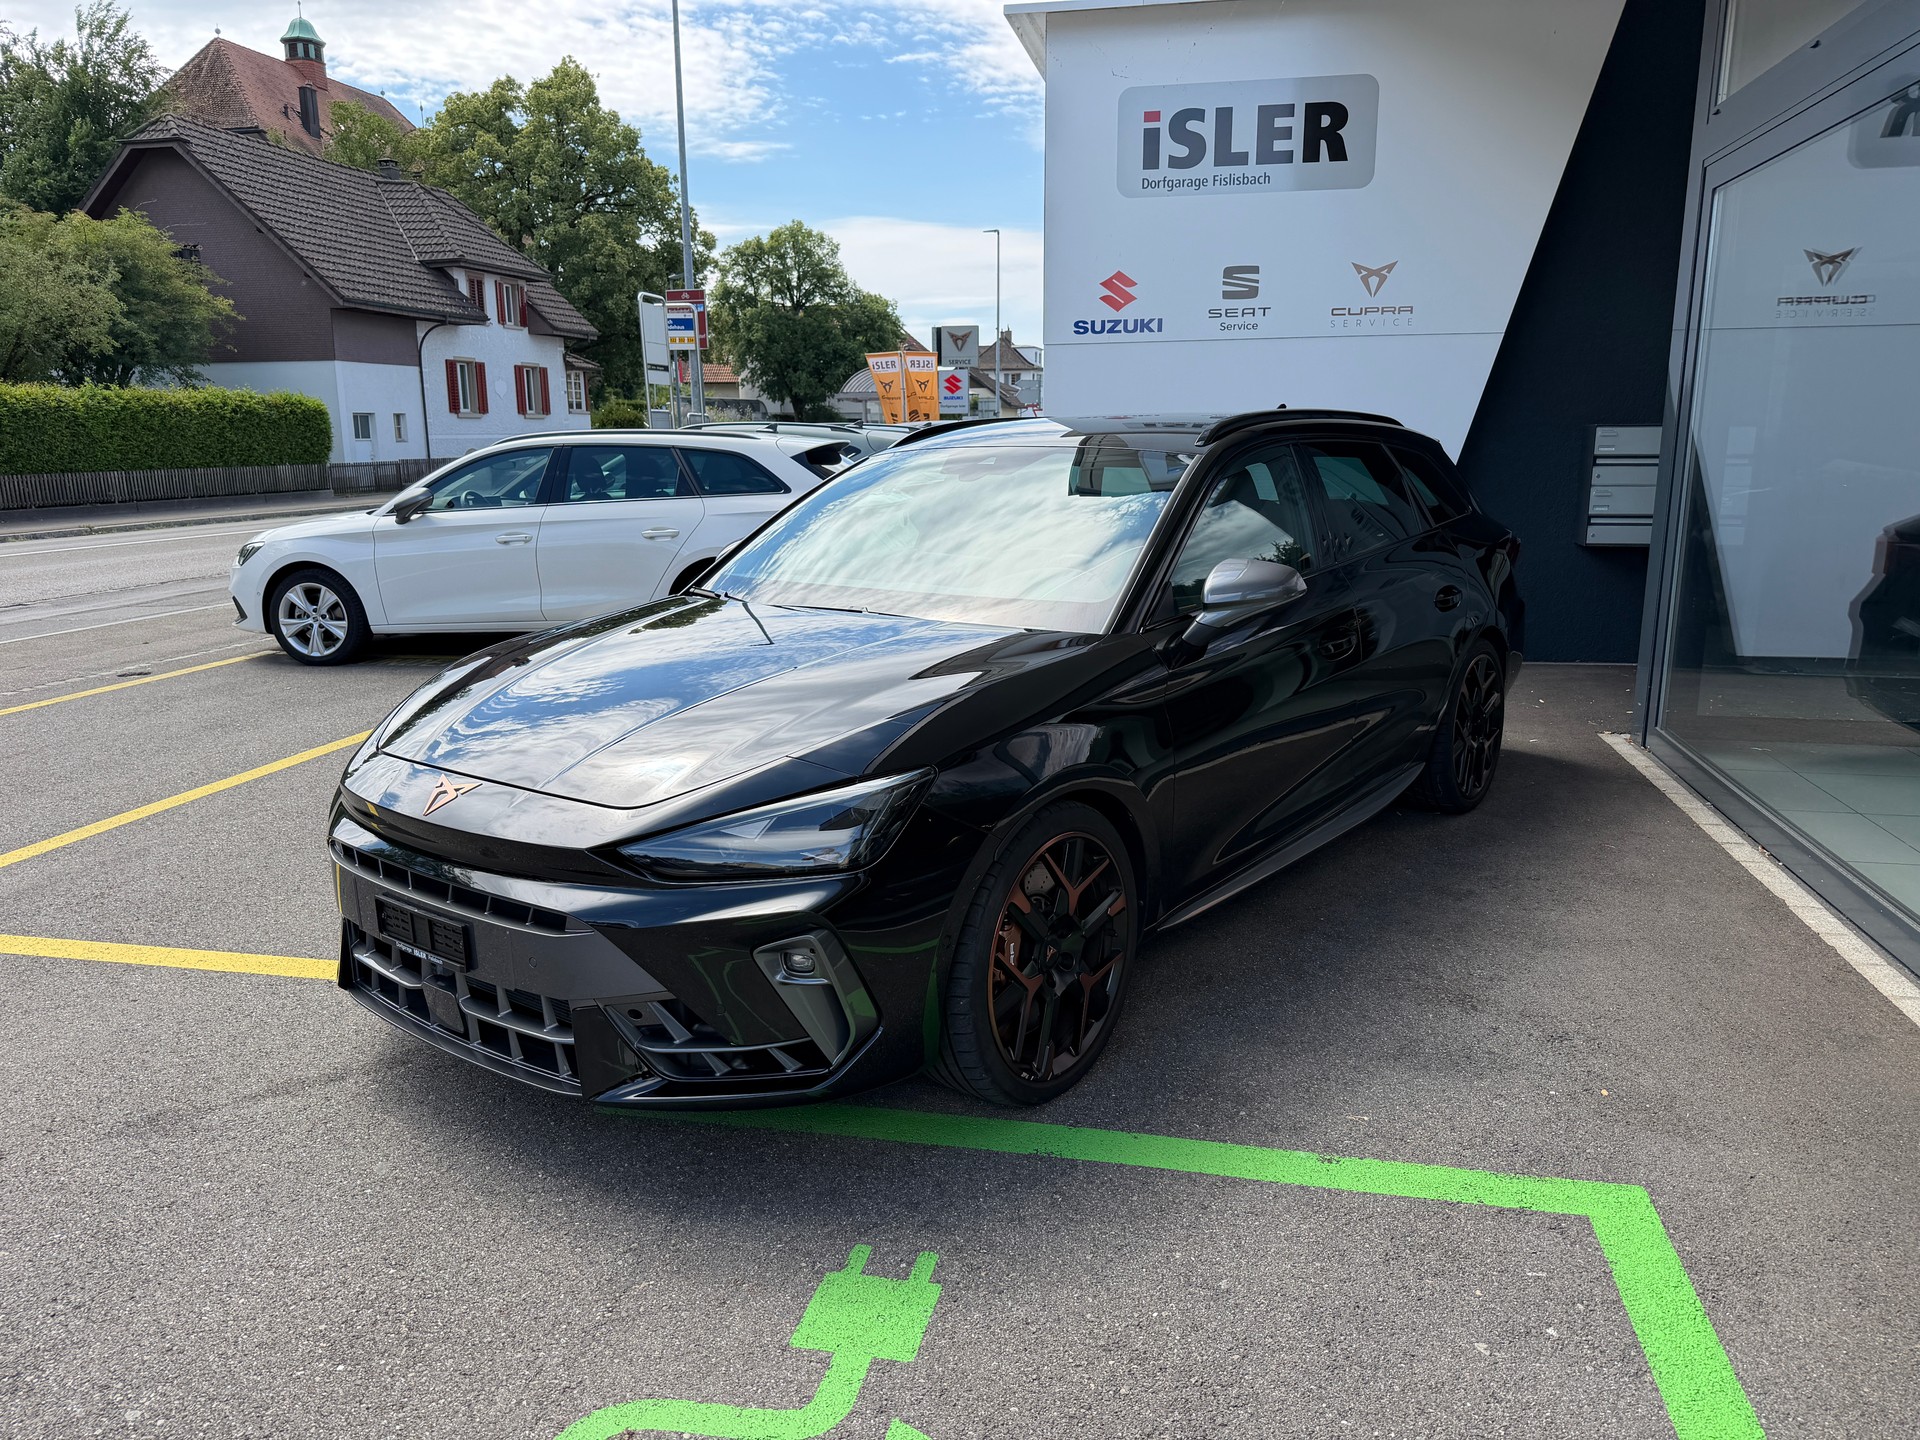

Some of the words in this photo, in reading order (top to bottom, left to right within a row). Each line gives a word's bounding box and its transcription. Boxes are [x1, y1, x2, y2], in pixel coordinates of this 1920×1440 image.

[1142, 101, 1349, 170] iSLER
[1141, 176, 1209, 192] Dorfgarage
[1212, 172, 1271, 187] Fislisbach
[1208, 307, 1272, 319] SEAT
[1331, 306, 1414, 317] CUPRA
[1073, 318, 1163, 335] SUZUKI
[1219, 321, 1259, 332] Service
[1330, 318, 1413, 328] SERVICE
[872, 360, 897, 370] iSLER
